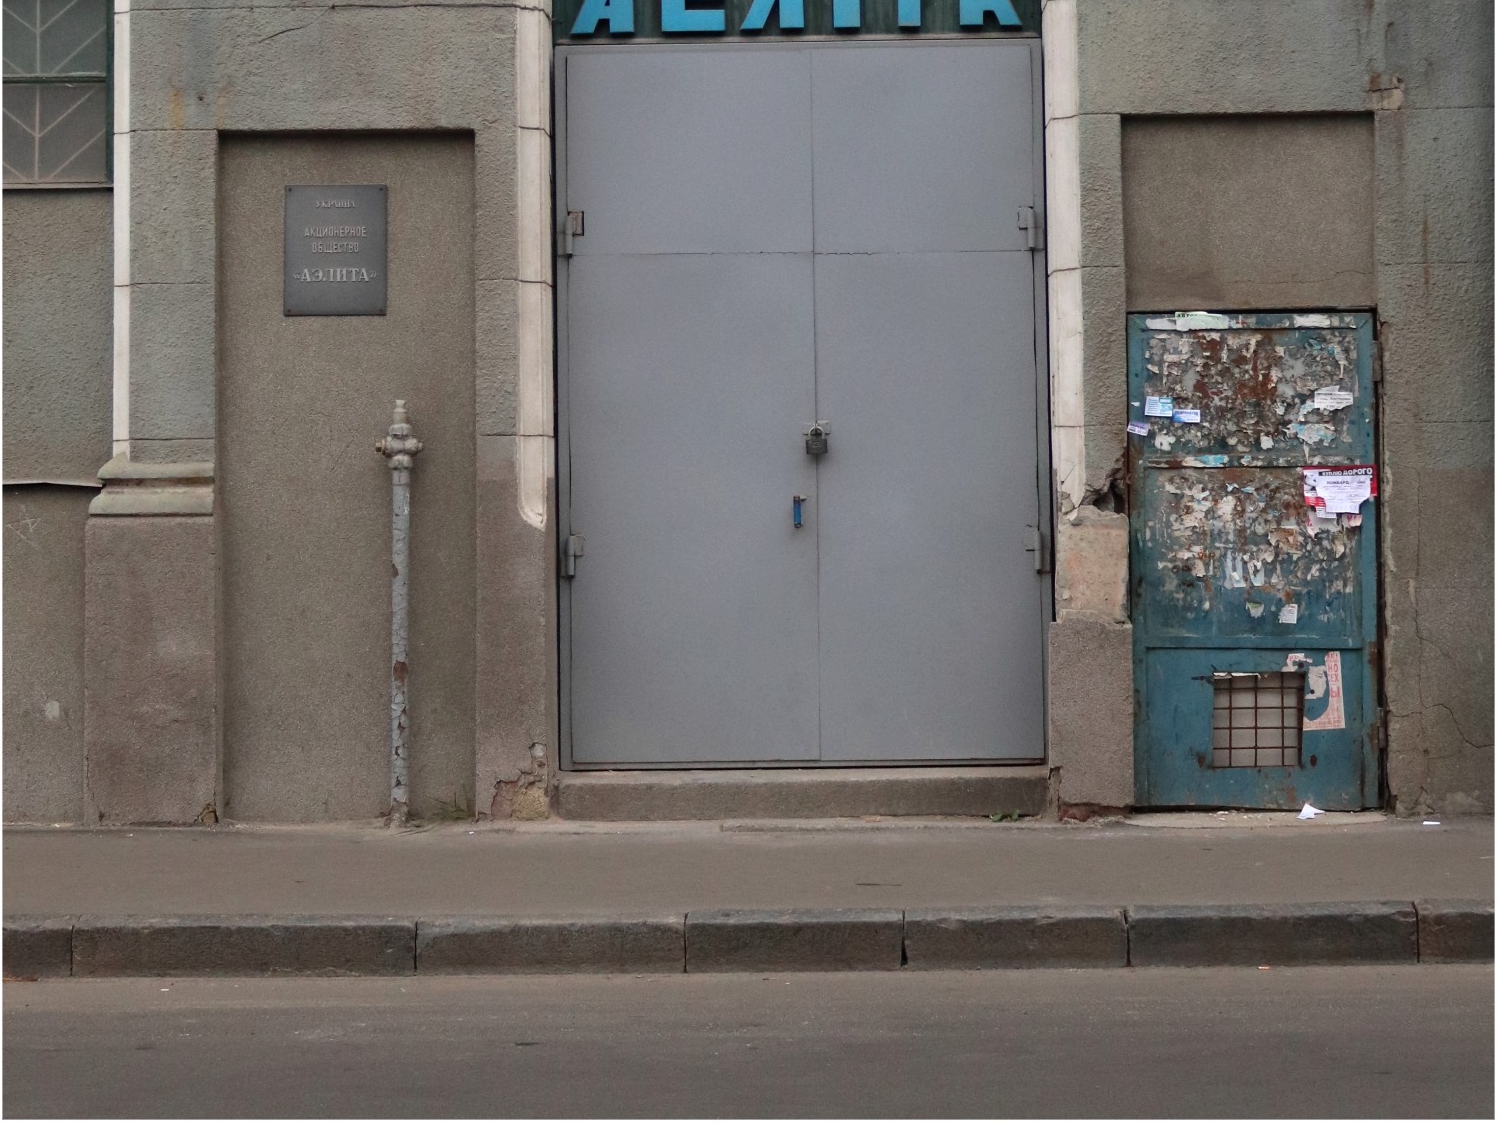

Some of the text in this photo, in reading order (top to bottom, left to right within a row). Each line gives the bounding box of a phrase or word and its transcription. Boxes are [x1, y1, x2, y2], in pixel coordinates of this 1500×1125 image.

[315, 199, 356, 209] УКРАИНА
[304, 226, 367, 238] АКЦИОНЕРНОЕ
[311, 242, 360, 254] ОБЩЕСТВО
[293, 268, 378, 283] «АЭЛИТА»
[1343, 467, 1373, 476] ДОРОГО
